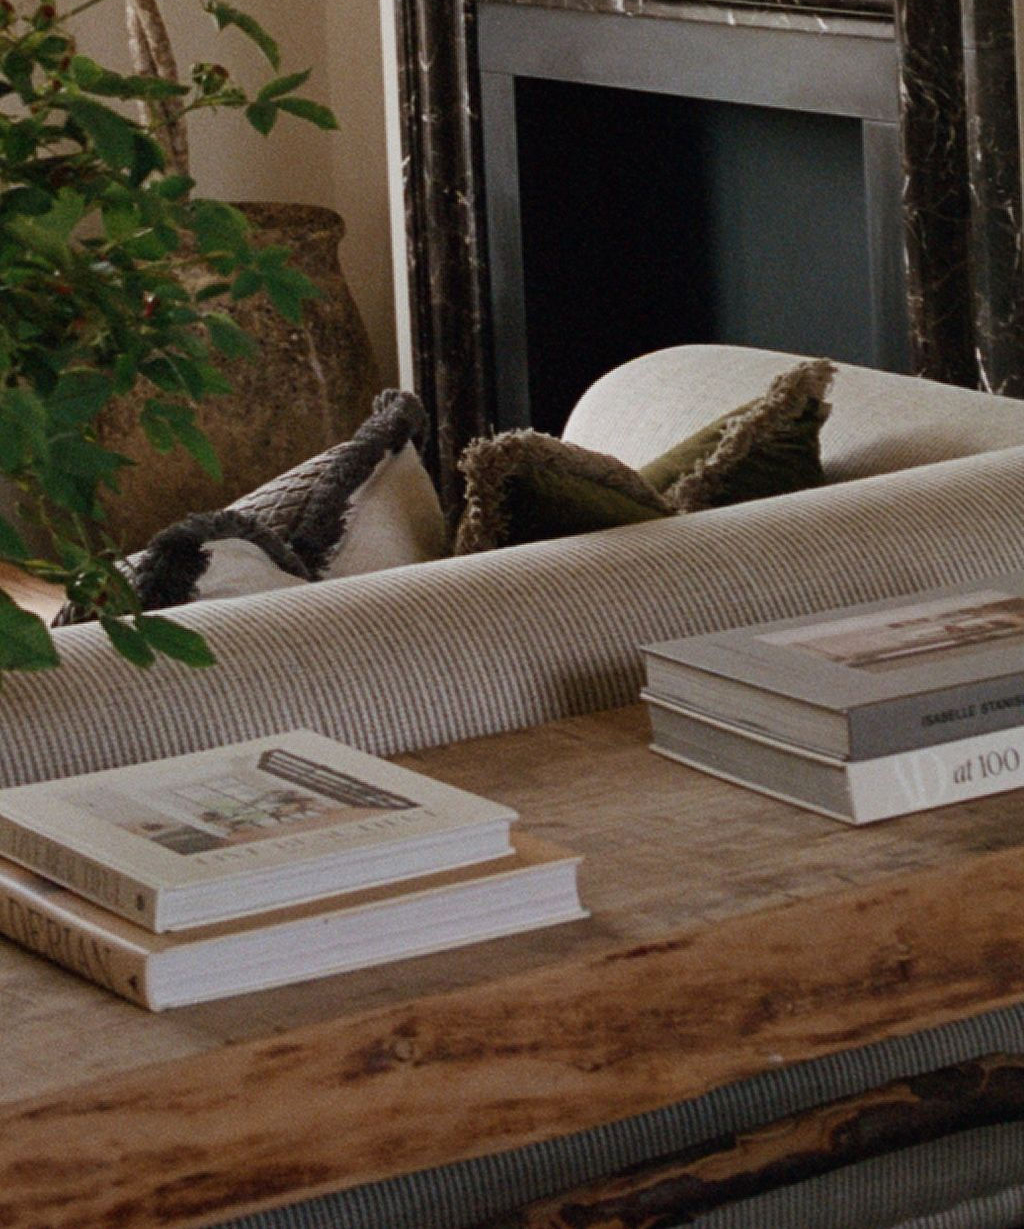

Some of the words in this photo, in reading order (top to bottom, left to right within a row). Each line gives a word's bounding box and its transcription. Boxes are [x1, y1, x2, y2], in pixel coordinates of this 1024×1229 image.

[921, 704, 977, 728] ISABELLE
[952, 757, 974, 784] at
[978, 746, 1021, 778] 100
